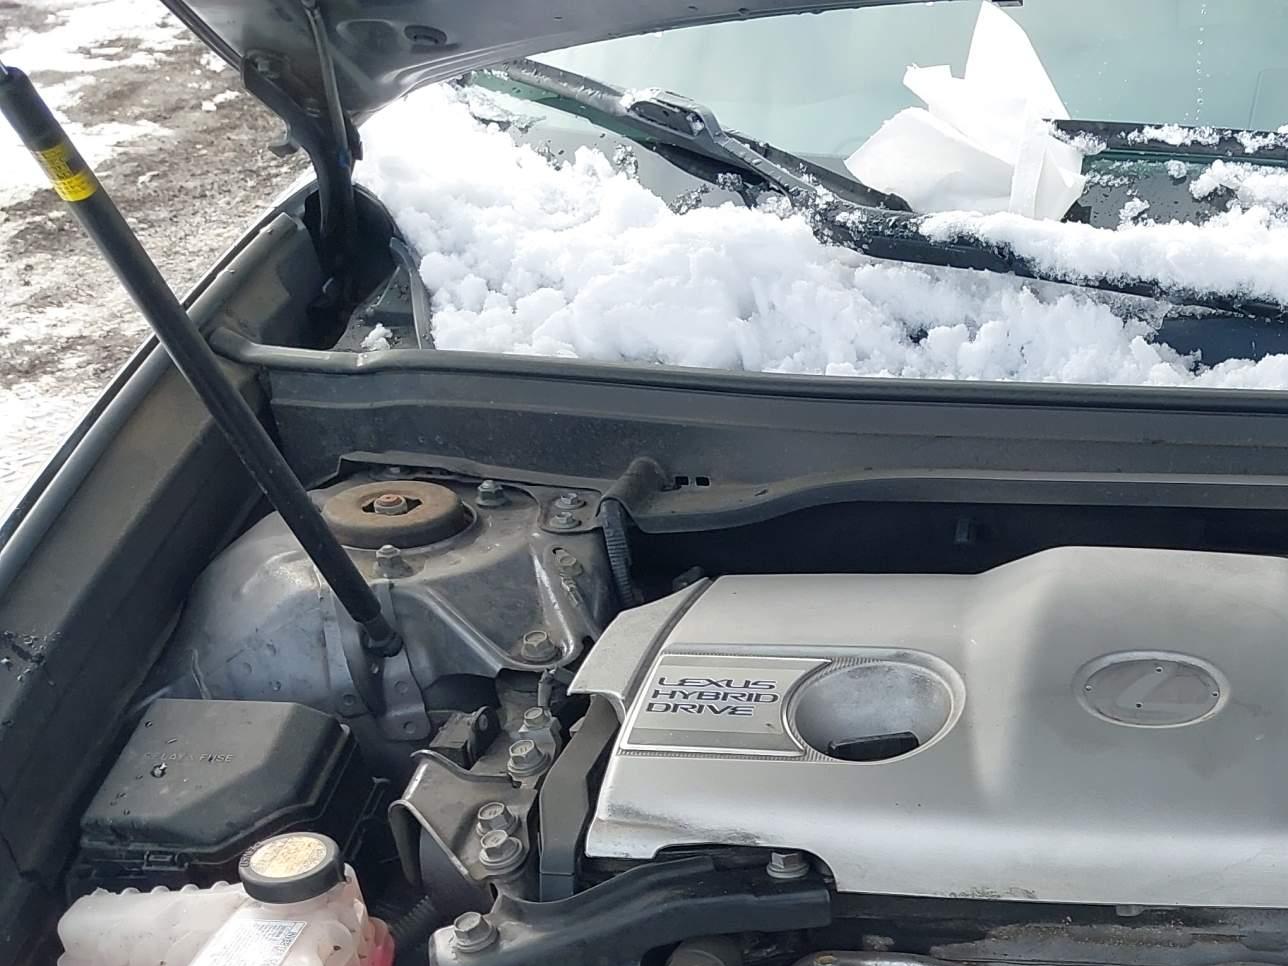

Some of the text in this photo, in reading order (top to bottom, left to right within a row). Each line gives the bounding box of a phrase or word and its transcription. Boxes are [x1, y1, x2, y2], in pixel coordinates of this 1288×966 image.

[658, 677, 777, 690] LEXUS
[652, 689, 779, 703] HYBRID
[646, 702, 754, 716] DRIVE
